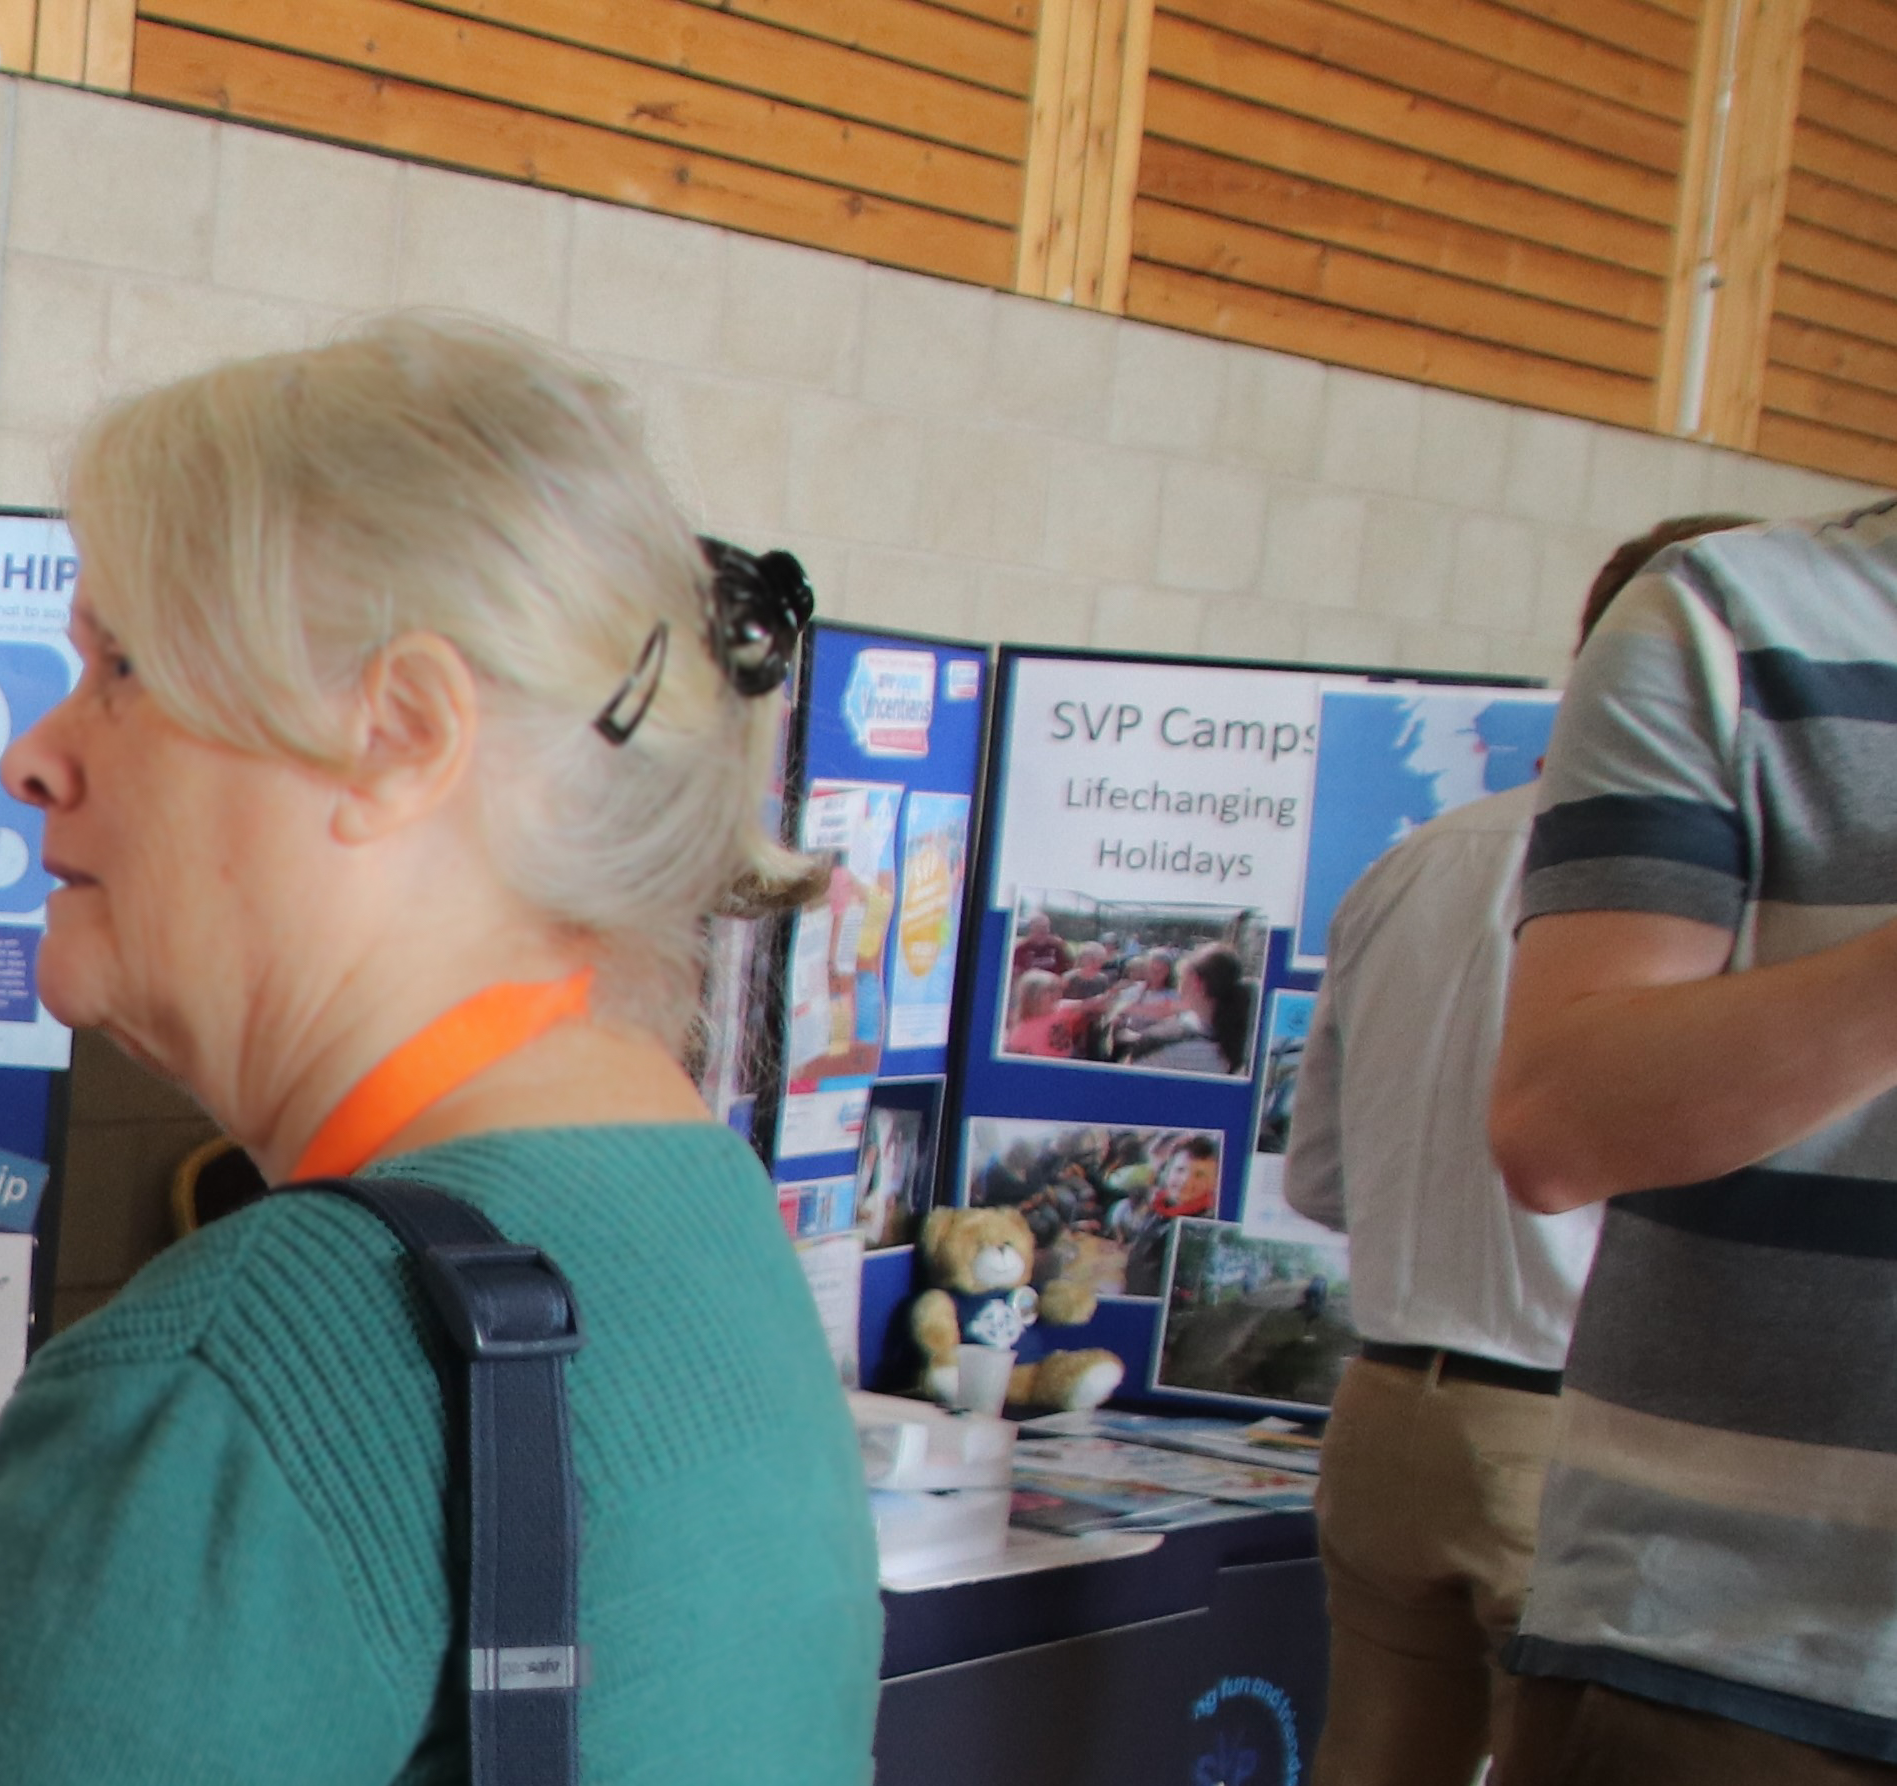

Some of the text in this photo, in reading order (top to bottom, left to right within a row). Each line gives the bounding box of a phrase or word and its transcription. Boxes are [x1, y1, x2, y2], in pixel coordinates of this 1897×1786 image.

[1051, 701, 1315, 762] SVP Camps
[1066, 777, 1298, 828] Lifechanging
[1098, 838, 1253, 883] Holidays
